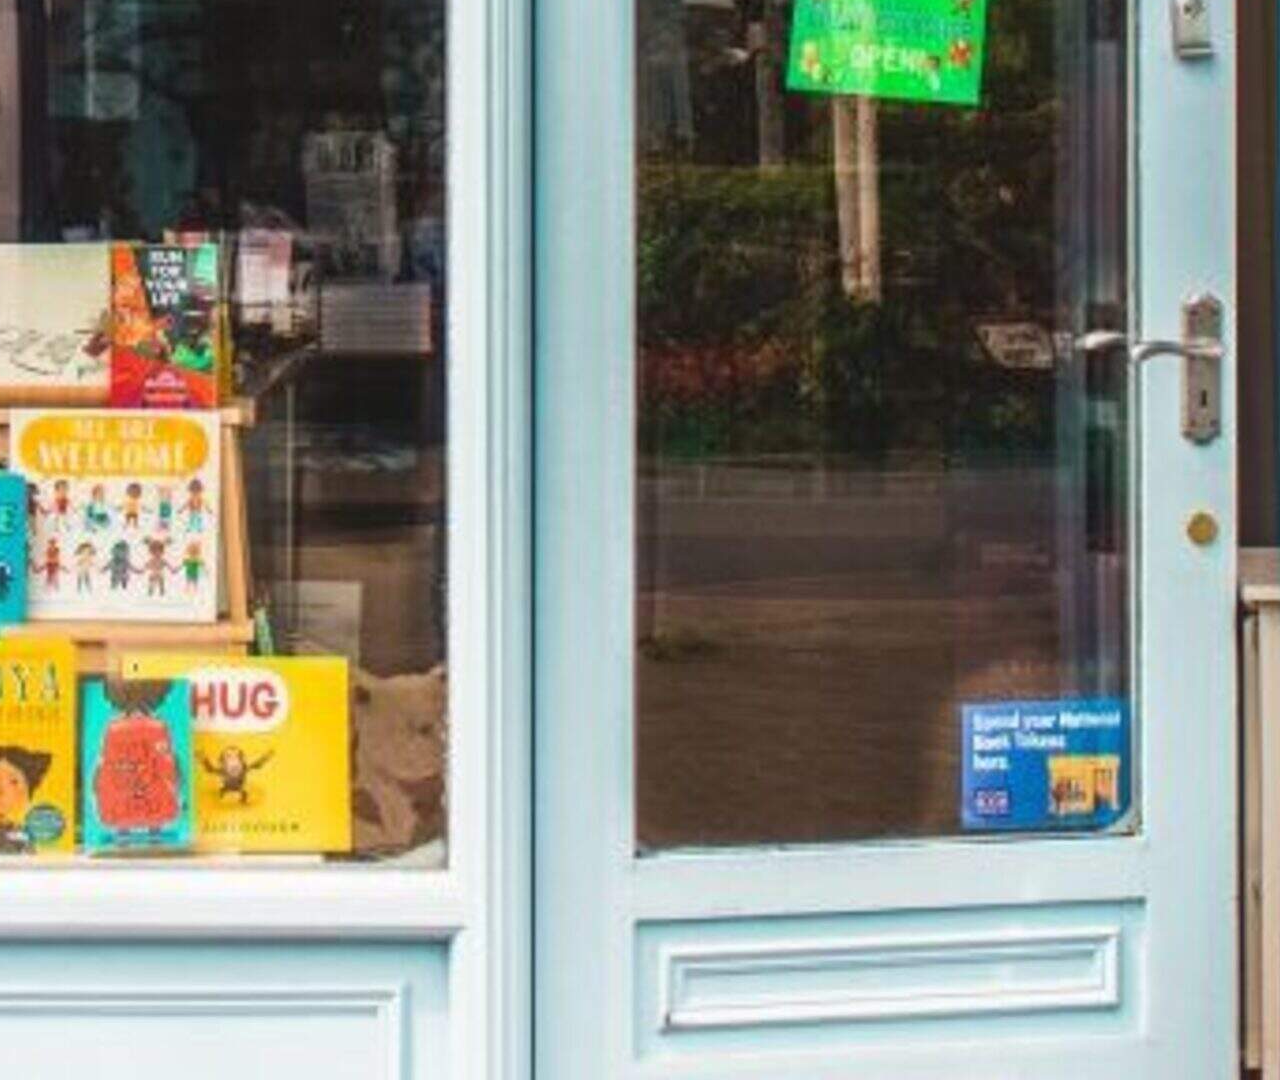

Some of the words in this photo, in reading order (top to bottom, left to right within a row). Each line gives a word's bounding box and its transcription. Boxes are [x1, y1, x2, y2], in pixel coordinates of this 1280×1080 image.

[150, 264, 182, 278] FOR
[37, 440, 187, 471] WELCOME
[190, 679, 280, 719] HUG
